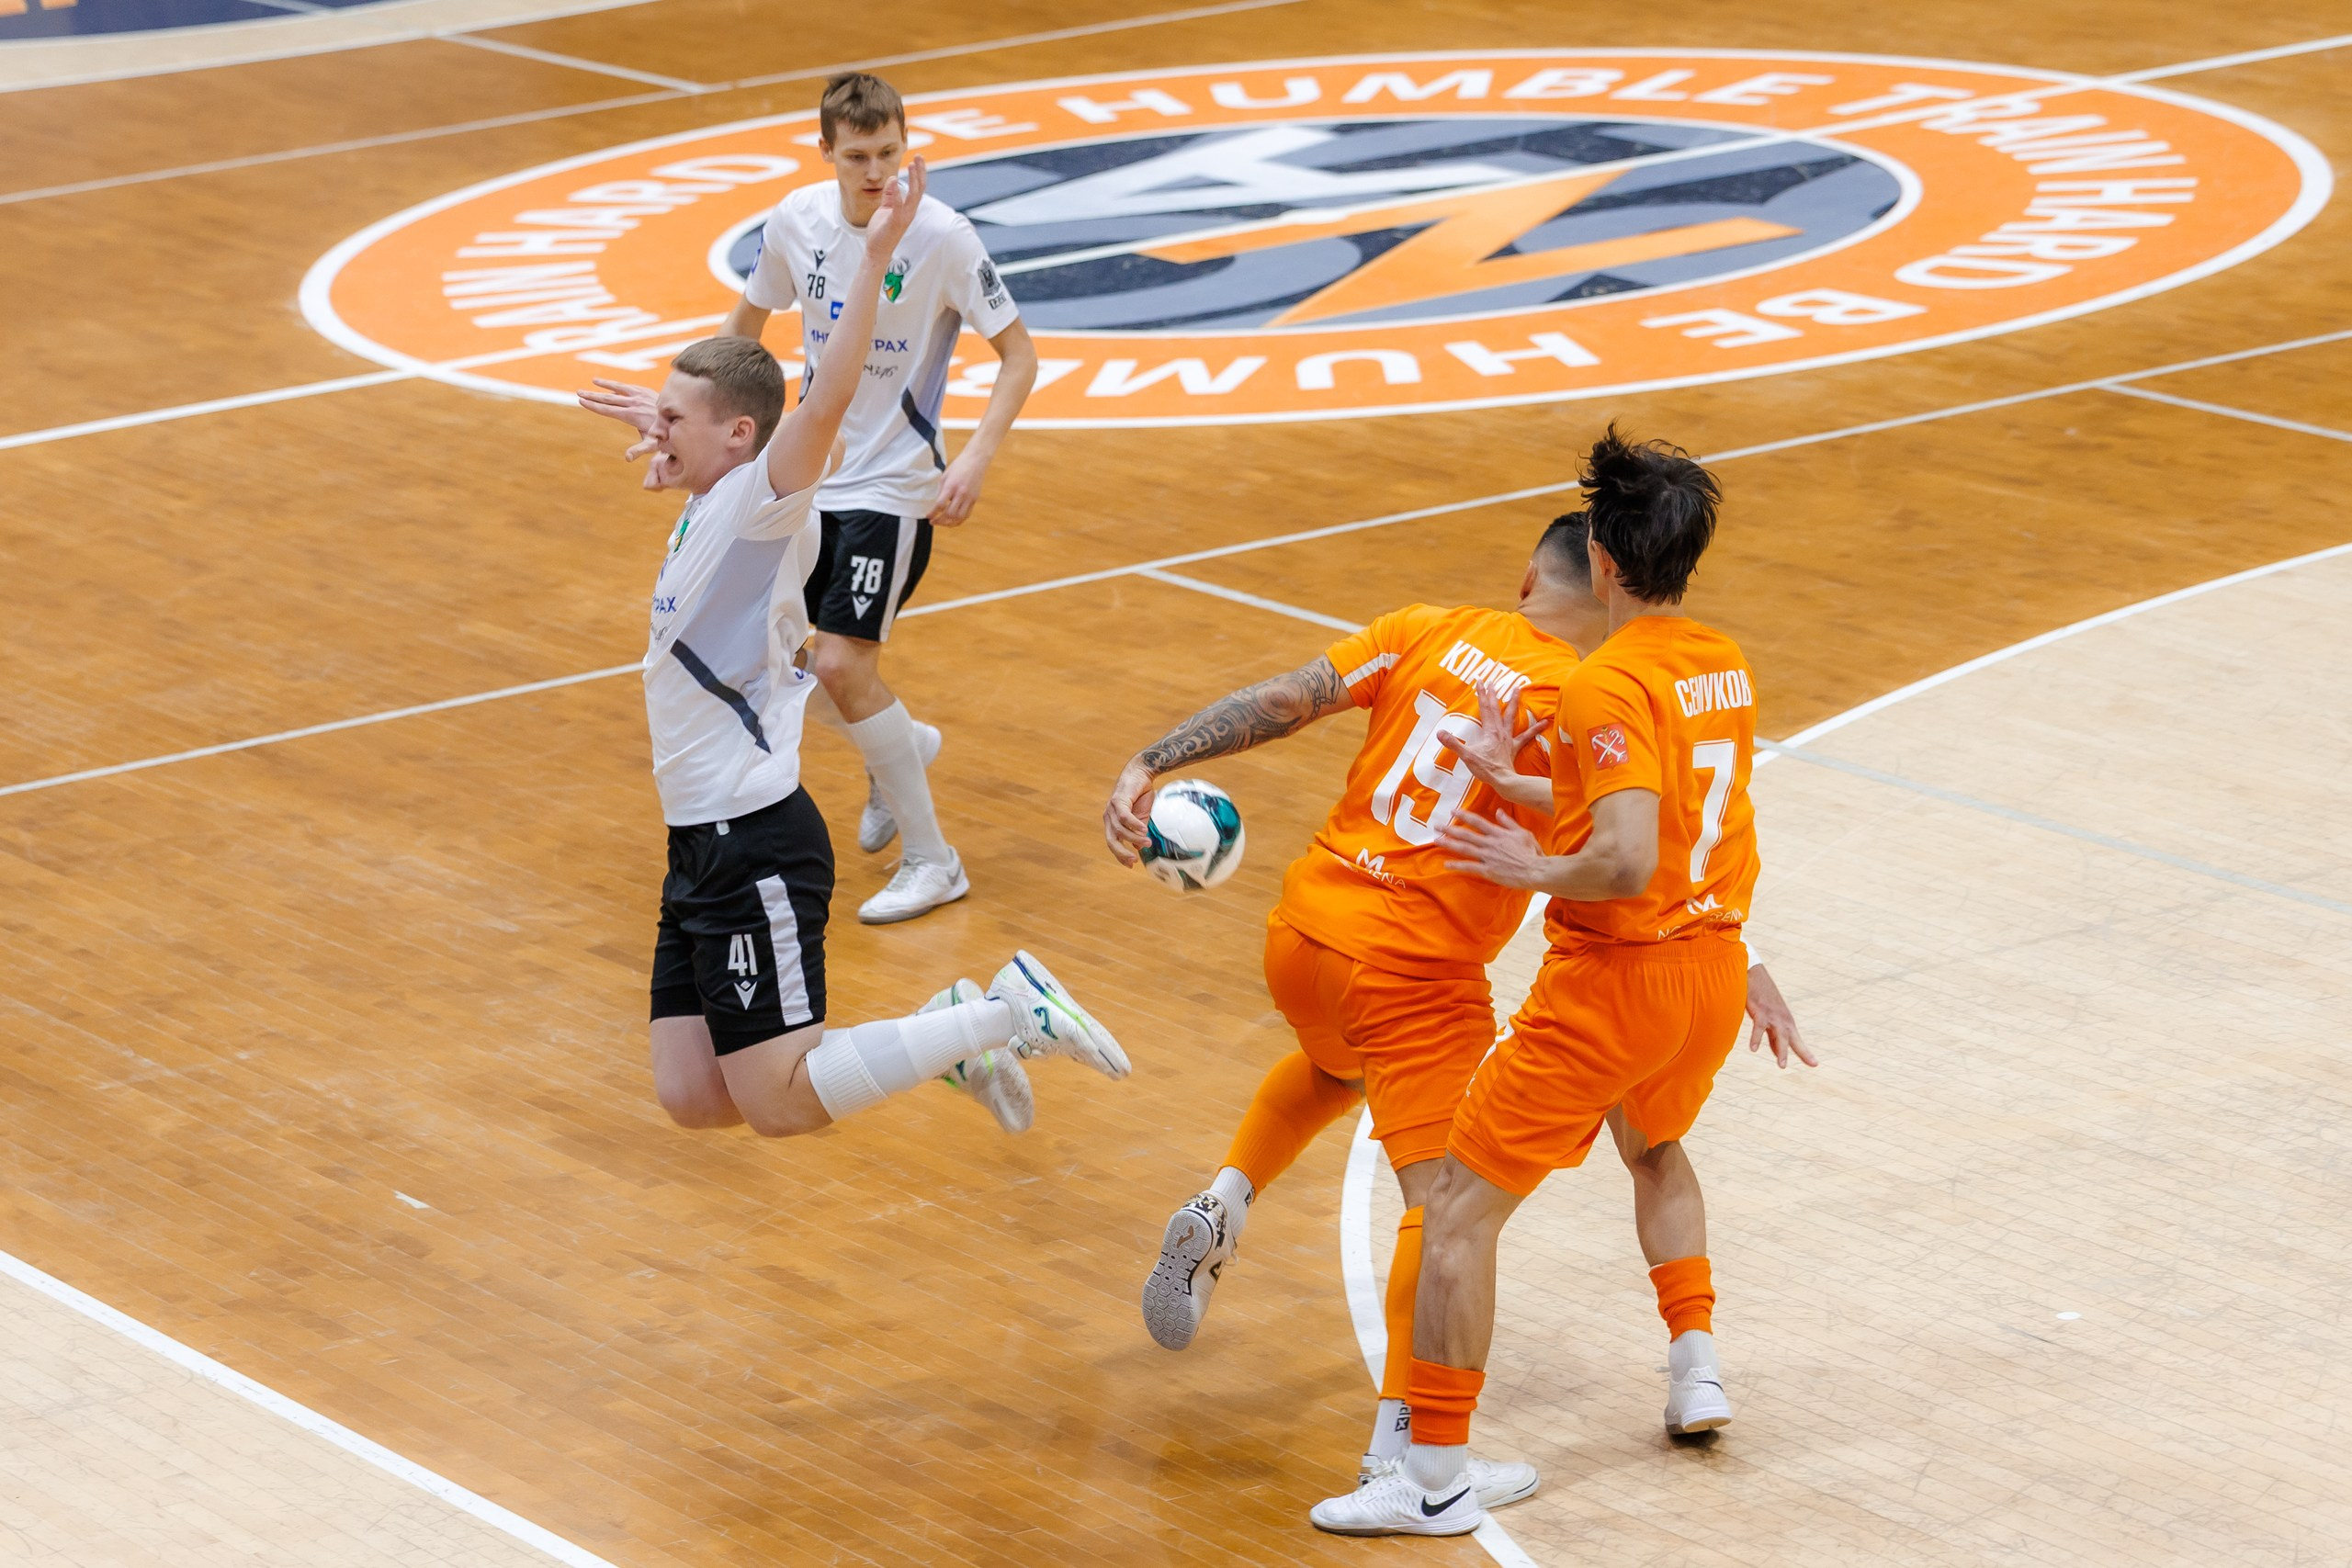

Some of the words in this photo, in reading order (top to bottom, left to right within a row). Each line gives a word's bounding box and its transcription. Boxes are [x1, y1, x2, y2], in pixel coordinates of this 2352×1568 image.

[455, 153, 801, 258] HARD
[1057, 67, 1836, 125] HUMBLE
[1827, 81, 2187, 175] TRAIN
[1894, 177, 2199, 290] HARD
[808, 273, 826, 299] 78
[1638, 287, 1928, 350] BE
[850, 555, 885, 594] 78
[1370, 687, 1485, 847] 19
[1689, 738, 1738, 883] 7
[727, 933, 759, 977] 41
